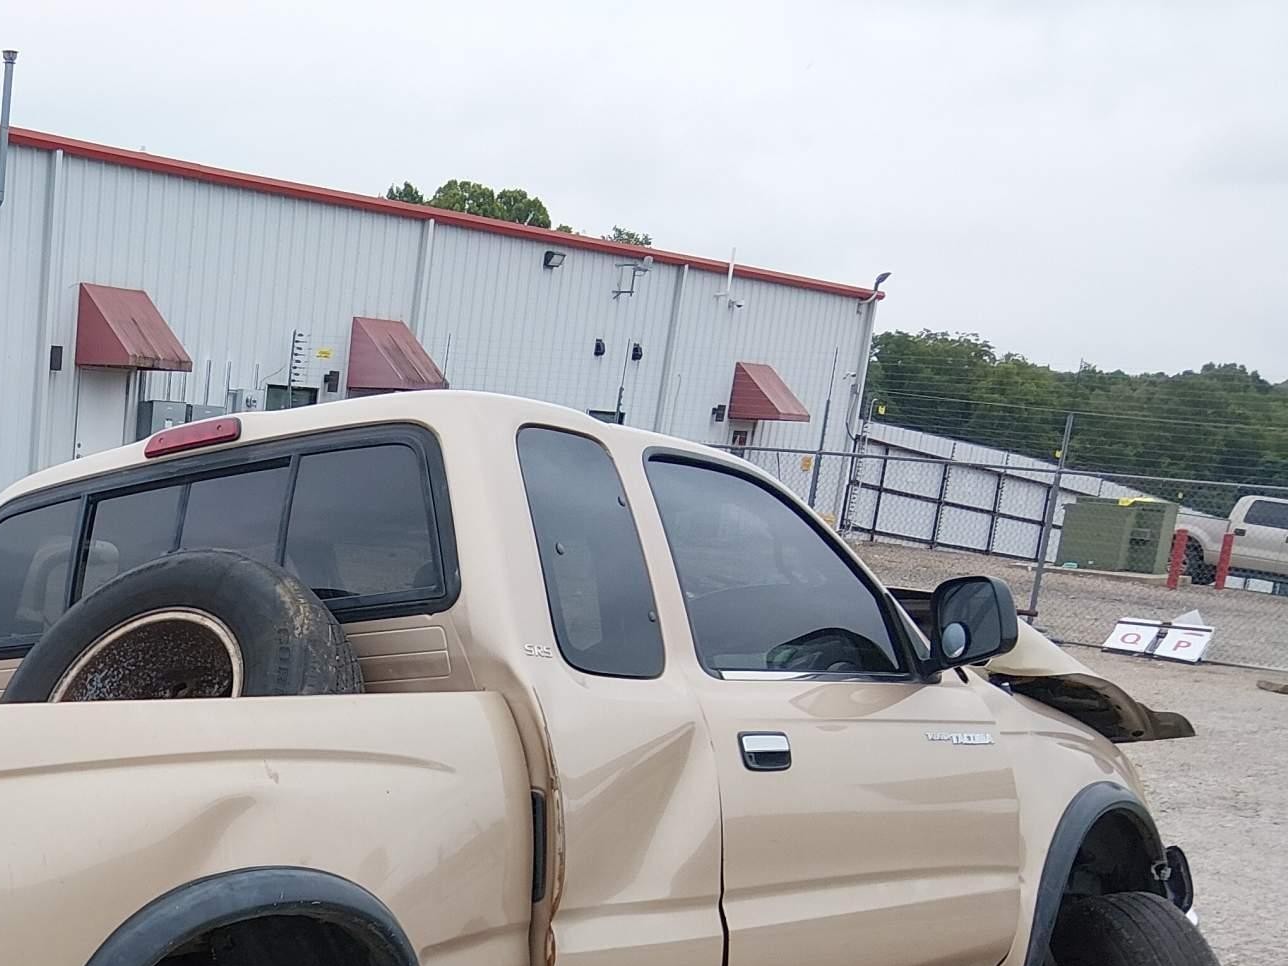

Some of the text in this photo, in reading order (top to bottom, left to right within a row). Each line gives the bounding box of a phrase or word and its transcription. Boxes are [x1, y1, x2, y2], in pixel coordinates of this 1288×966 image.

[1120, 632, 1142, 645] Q
[524, 643, 553, 658] SRS
[1172, 640, 1192, 652] P
